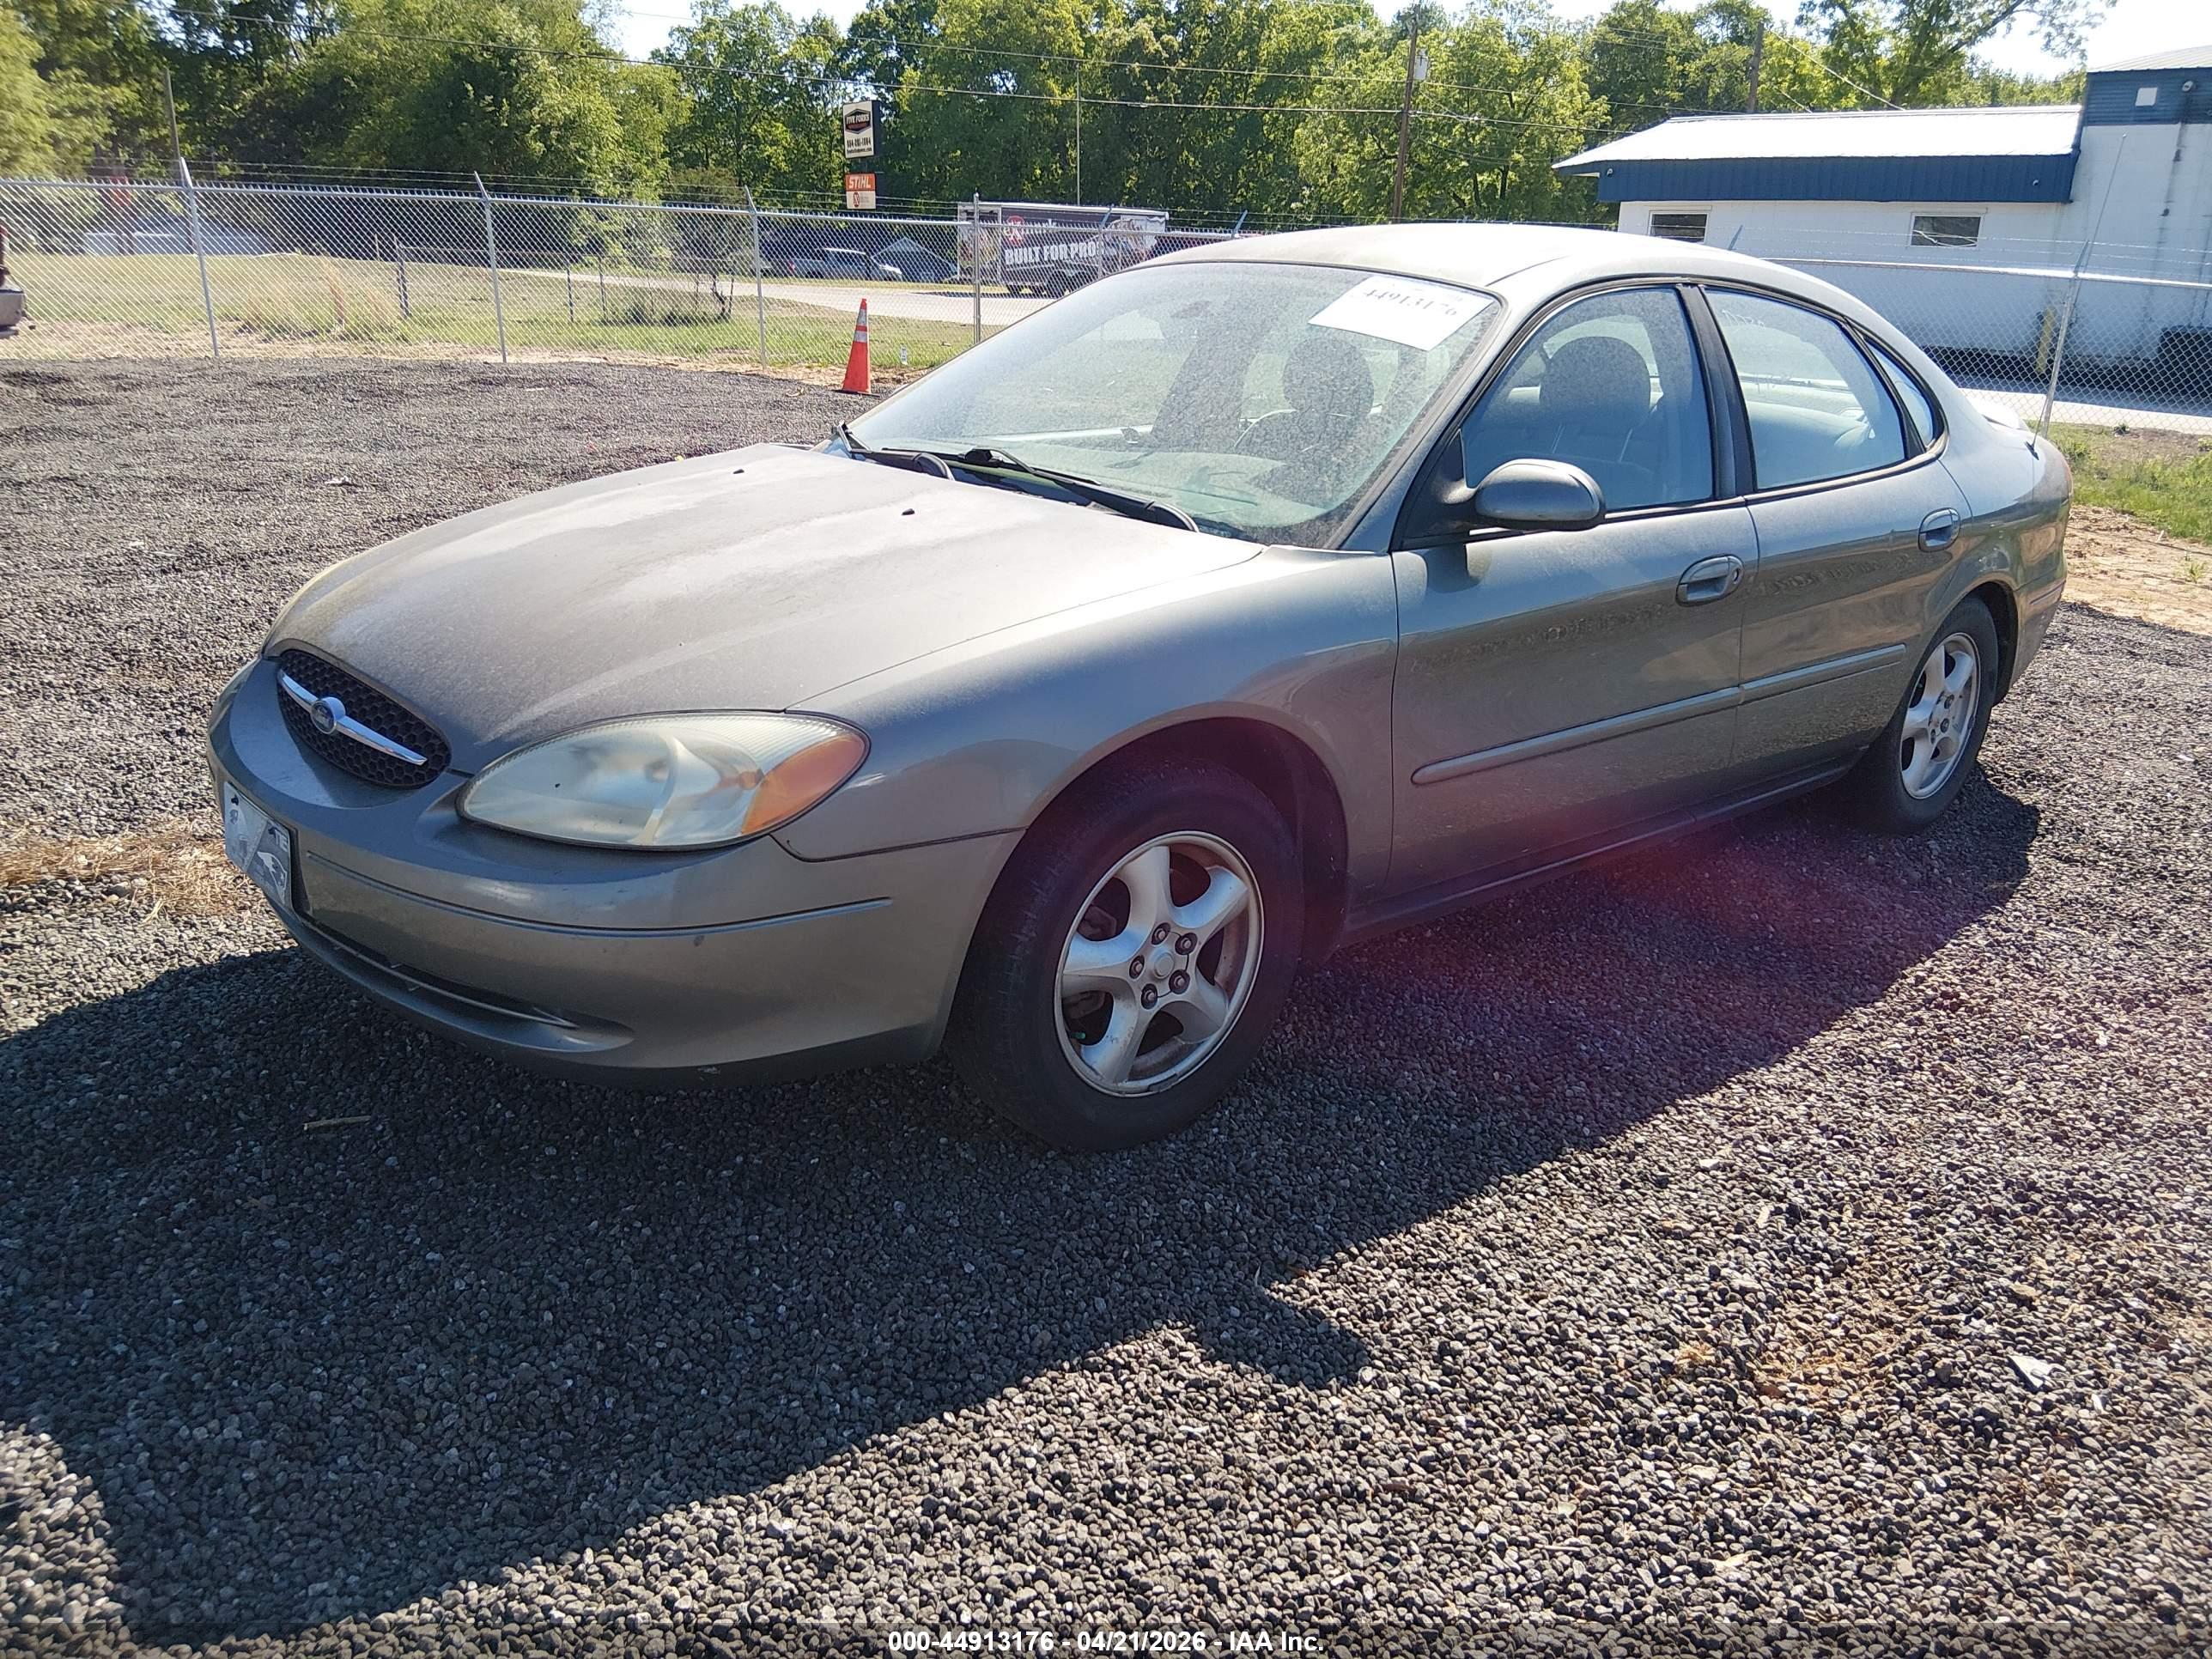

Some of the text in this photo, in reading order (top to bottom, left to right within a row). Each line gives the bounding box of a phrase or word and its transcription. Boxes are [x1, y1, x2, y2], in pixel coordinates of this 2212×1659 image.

[849, 175, 872, 189] STIHL
[1005, 246, 1041, 265] BUILT
[1043, 243, 1068, 261] FOR
